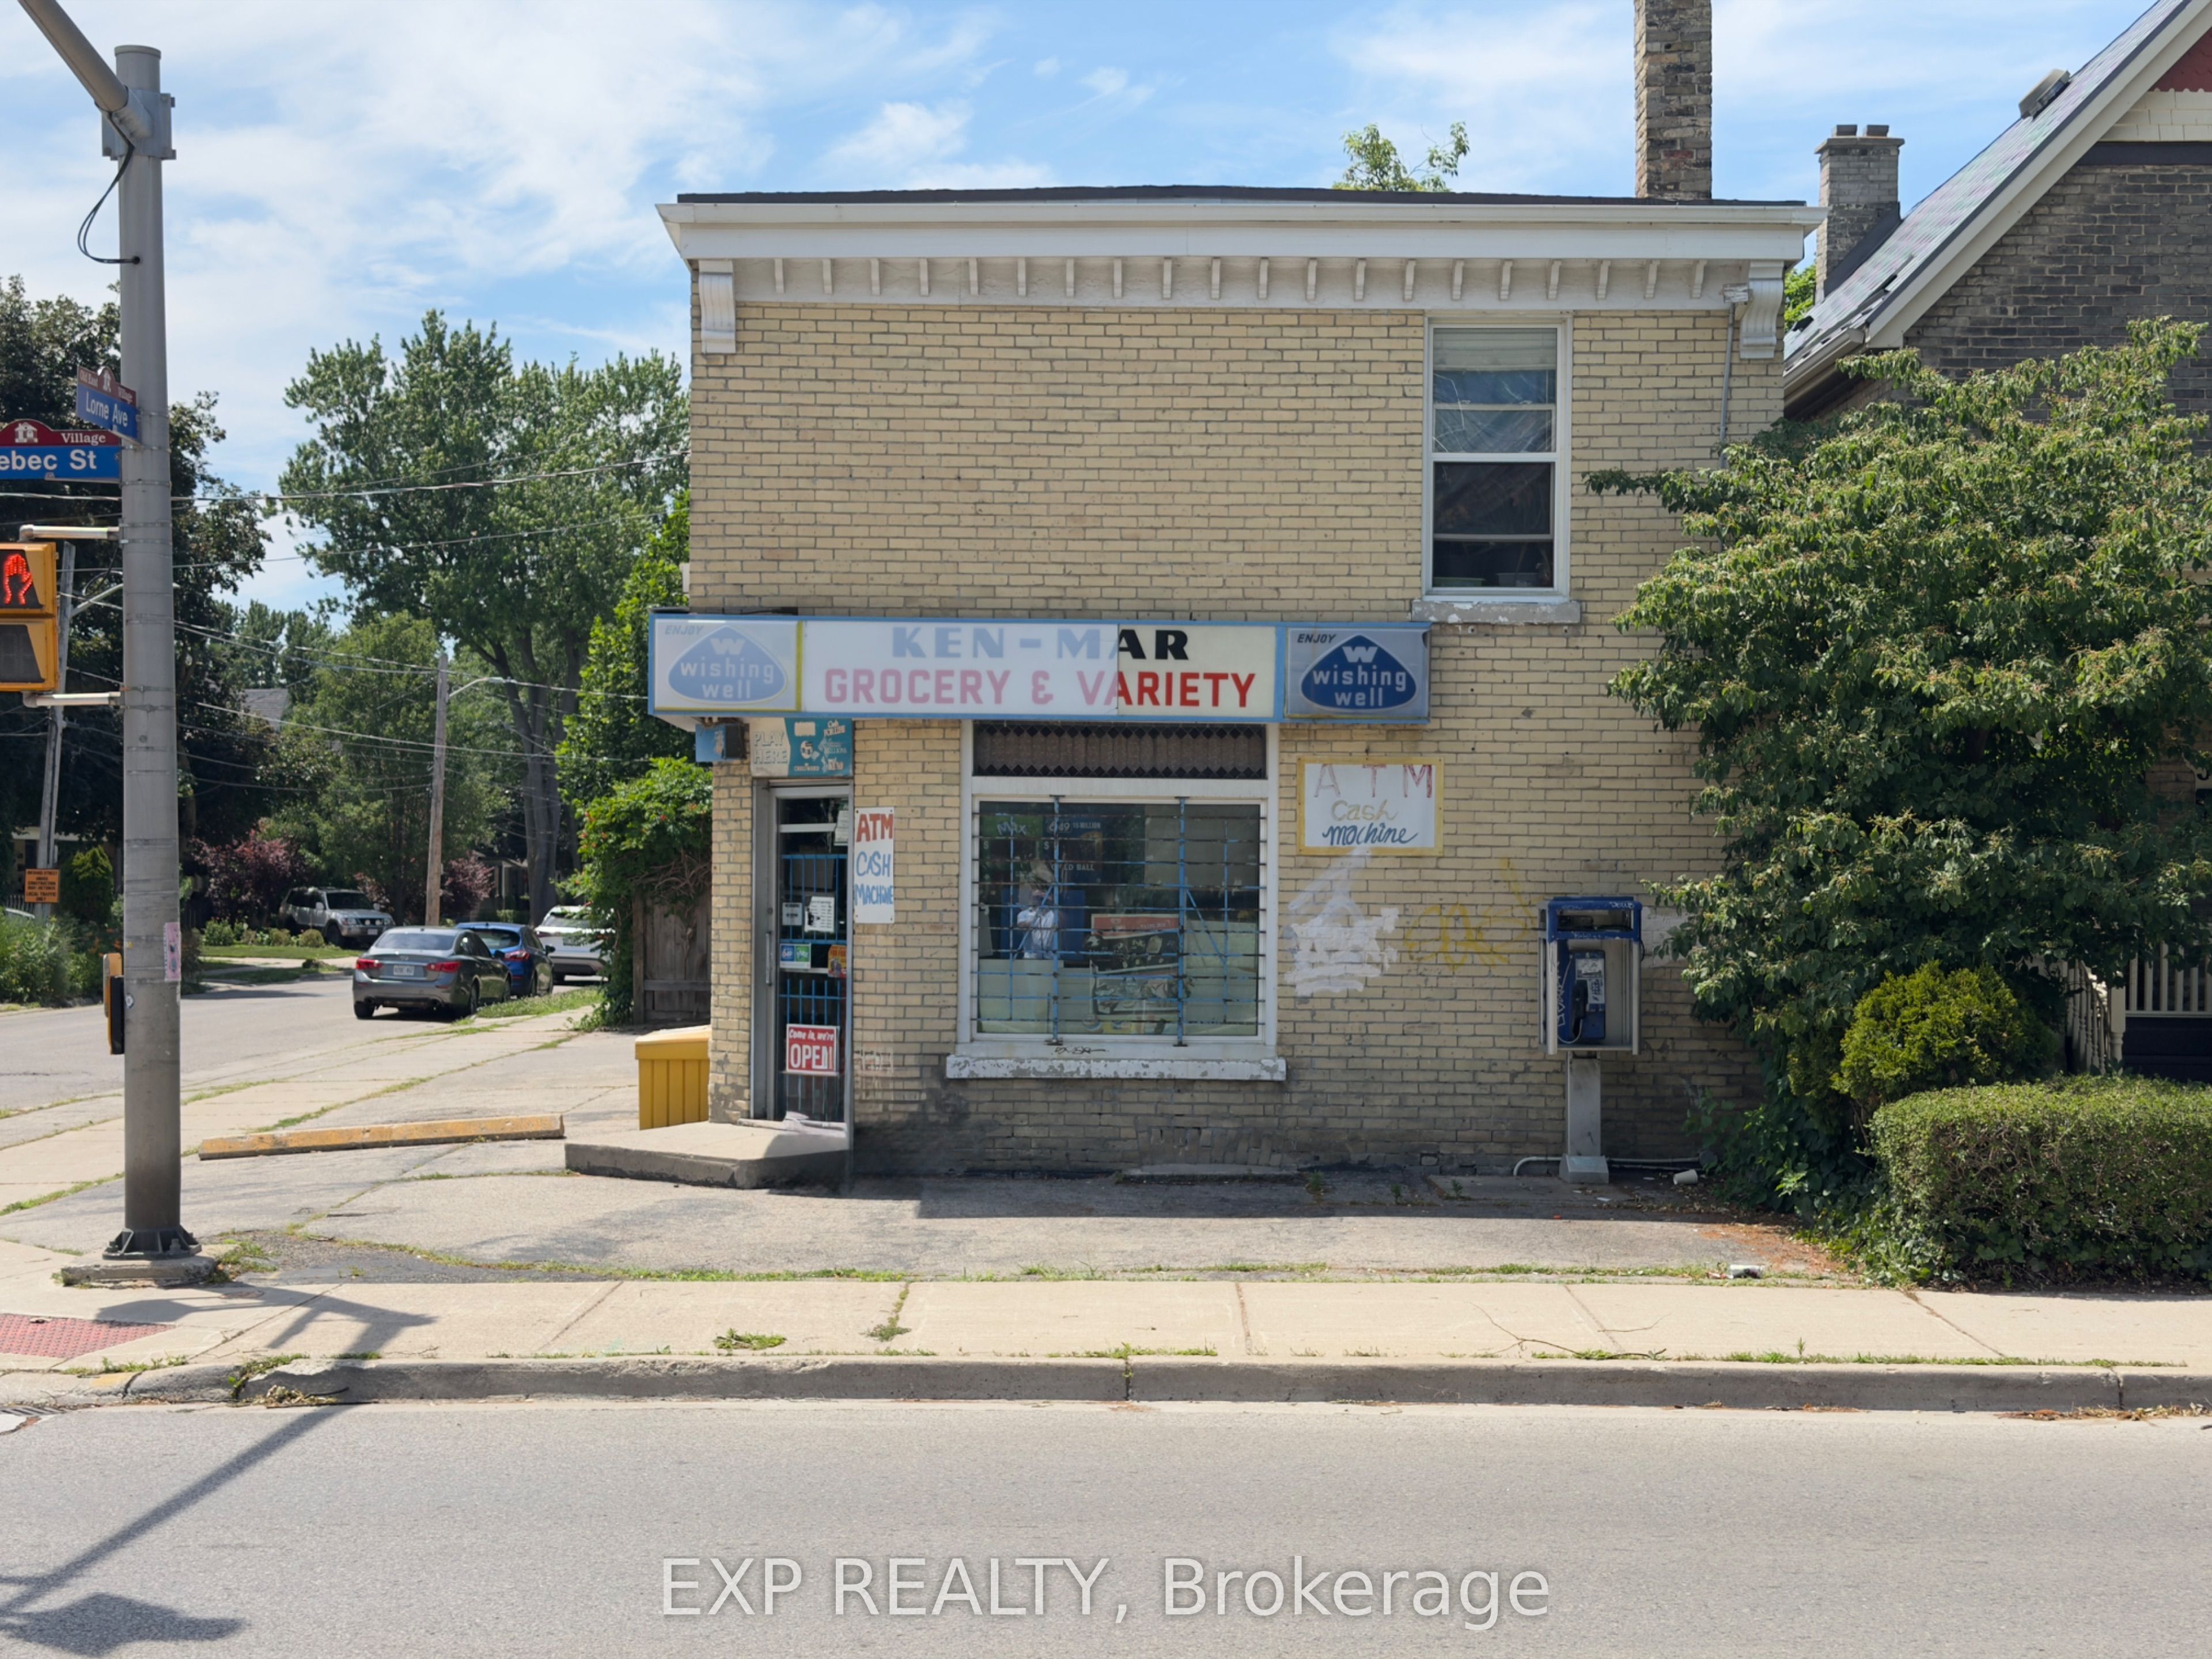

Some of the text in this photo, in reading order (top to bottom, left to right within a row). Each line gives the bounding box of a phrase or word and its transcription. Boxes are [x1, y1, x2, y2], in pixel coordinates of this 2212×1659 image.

[86, 391, 128, 427] Lorne Ave
[60, 433, 106, 446] Village
[69, 449, 97, 470] St
[665, 625, 704, 635] ENJOY
[1297, 634, 1336, 643] ENJOY
[892, 627, 1189, 660] KEN-MAR
[680, 656, 774, 684] wishing
[1312, 665, 1406, 692] wishing
[702, 679, 751, 699] well
[825, 668, 1256, 707] GROCERY & VARIETY
[1334, 687, 1383, 706] well
[753, 732, 785, 747] PLAY
[753, 749, 789, 764] HERE
[1313, 764, 1433, 798] ATM
[1330, 800, 1399, 822] Cash
[856, 813, 893, 842] ATM
[856, 851, 891, 877] CASH
[789, 1029, 806, 1039] Come
[808, 1030, 816, 1041] in,
[790, 1043, 832, 1069] OPEN
